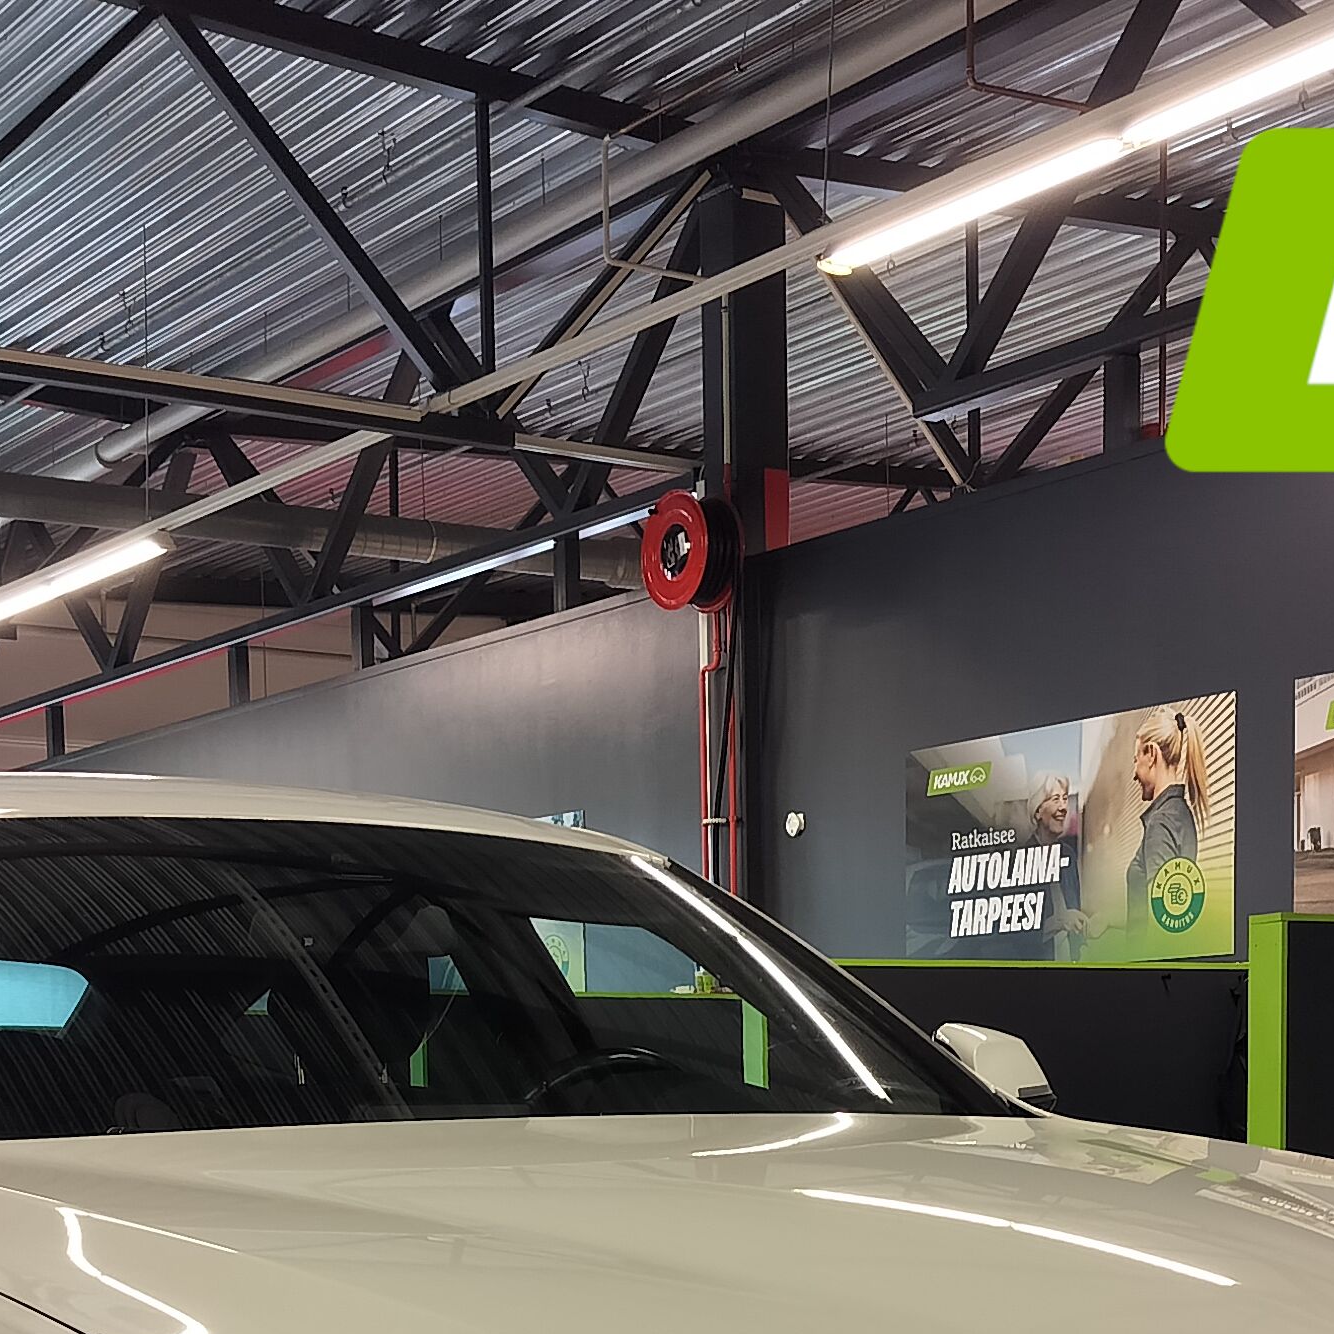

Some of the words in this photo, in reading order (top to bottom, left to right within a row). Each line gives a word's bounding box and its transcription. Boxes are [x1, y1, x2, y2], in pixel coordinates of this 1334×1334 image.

[933, 770, 971, 790] KAMUX
[951, 827, 1016, 851] Ratkaisee
[947, 844, 1070, 895] AUTOLAINA-
[1155, 861, 1201, 890] KAMUX
[950, 891, 1045, 938] TARPEESI
